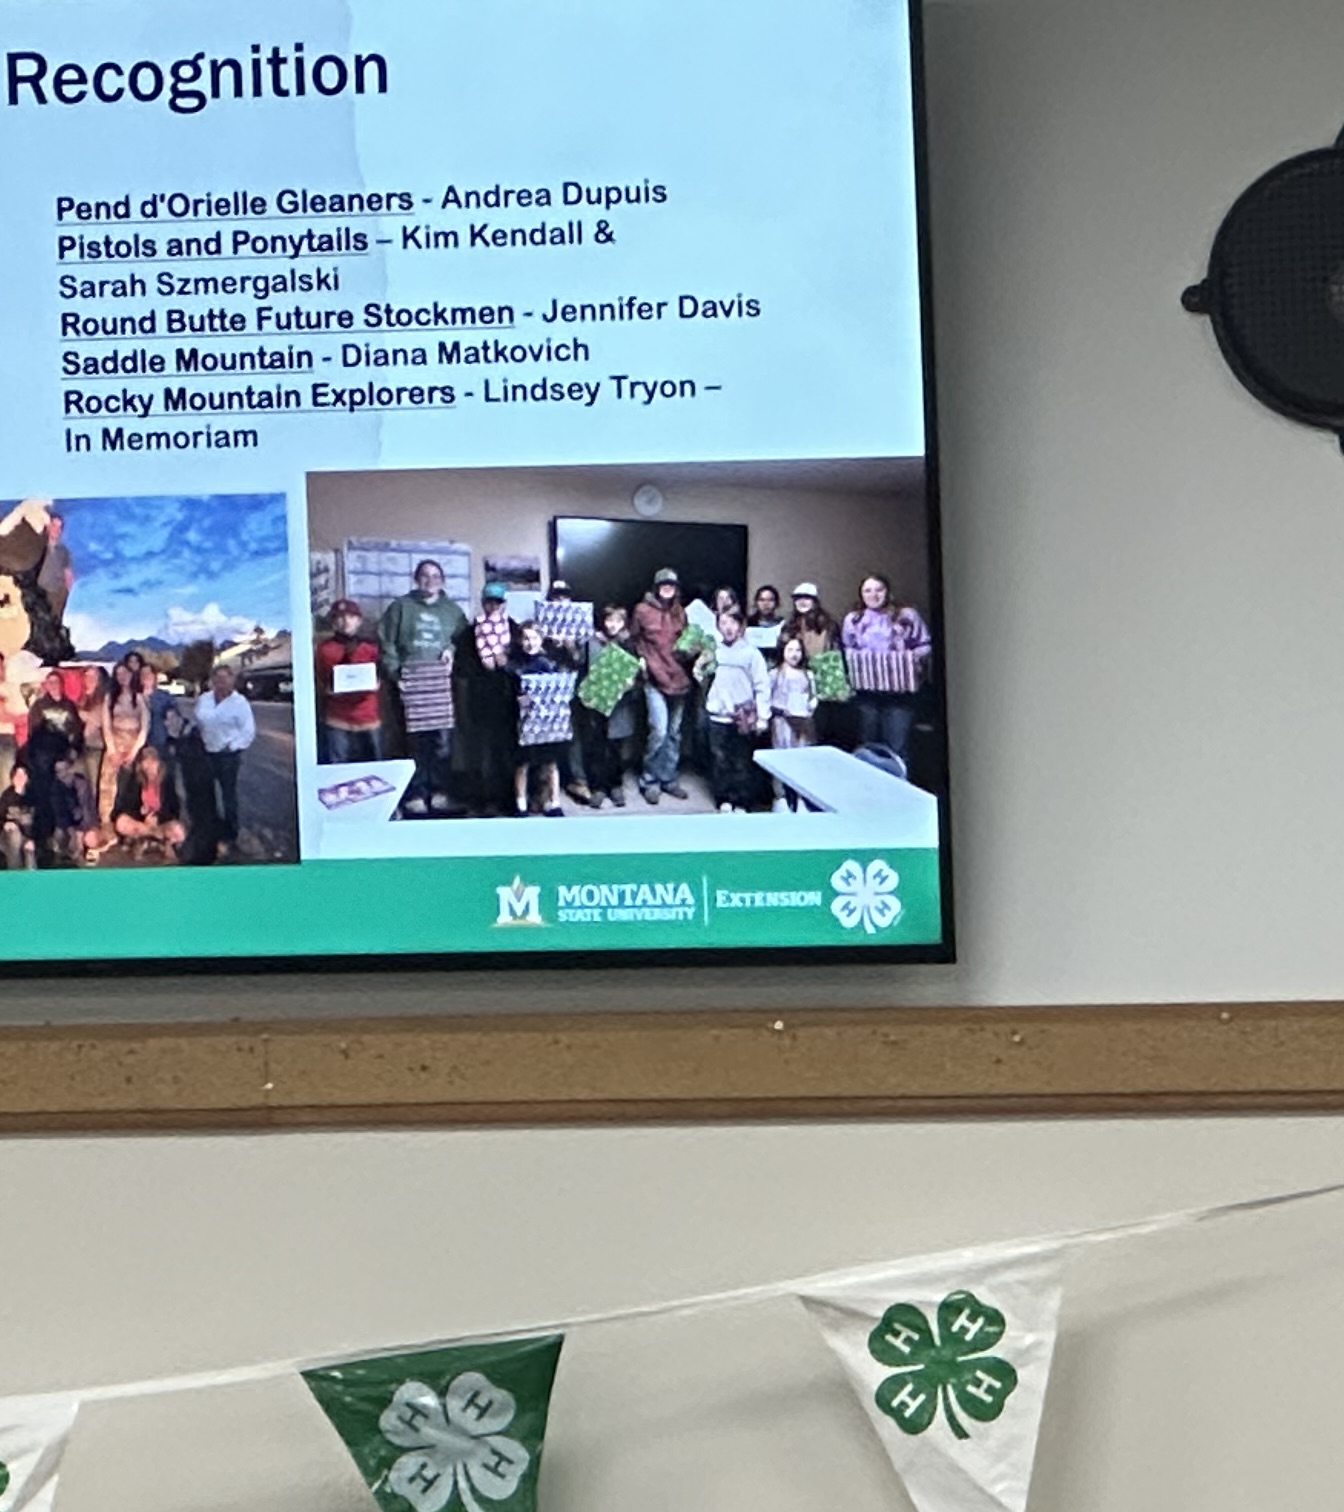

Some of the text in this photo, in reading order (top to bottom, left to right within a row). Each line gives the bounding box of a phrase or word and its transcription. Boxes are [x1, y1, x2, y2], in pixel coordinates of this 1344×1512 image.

[6, 42, 388, 115] Recognition
[56, 194, 131, 222] Pend
[140, 190, 267, 219] d'Orielle
[276, 188, 414, 215] Gleaners
[441, 184, 552, 210] Andrea
[562, 179, 667, 211] Dupuis
[58, 233, 158, 261] Pistols
[166, 230, 222, 257] and
[232, 226, 369, 260] Ponytails
[402, 225, 459, 250] Kim
[469, 220, 583, 248] Kendall
[594, 219, 616, 245] &
[59, 266, 340, 300] Sarah Szmergalski
[60, 308, 157, 337] Round
[166, 307, 247, 334] Butte
[256, 305, 354, 332] Future
[363, 301, 515, 328] Stockmen
[541, 295, 668, 324] Jennifer
[678, 293, 761, 319] Davis
[62, 348, 166, 376] Saddle
[175, 344, 313, 373] Mountain
[341, 342, 428, 368] Diana
[438, 337, 590, 365] Matkovich
[63, 387, 154, 419] Rocky
[163, 383, 302, 412] Mountain
[311, 381, 456, 413] Explorers
[484, 377, 601, 407] Lindsey
[609, 375, 696, 406] Tryon
[65, 424, 258, 453] In Memoriam
[558, 883, 695, 907] MONTANA
[558, 906, 696, 922] STATE UNIVERSITY
